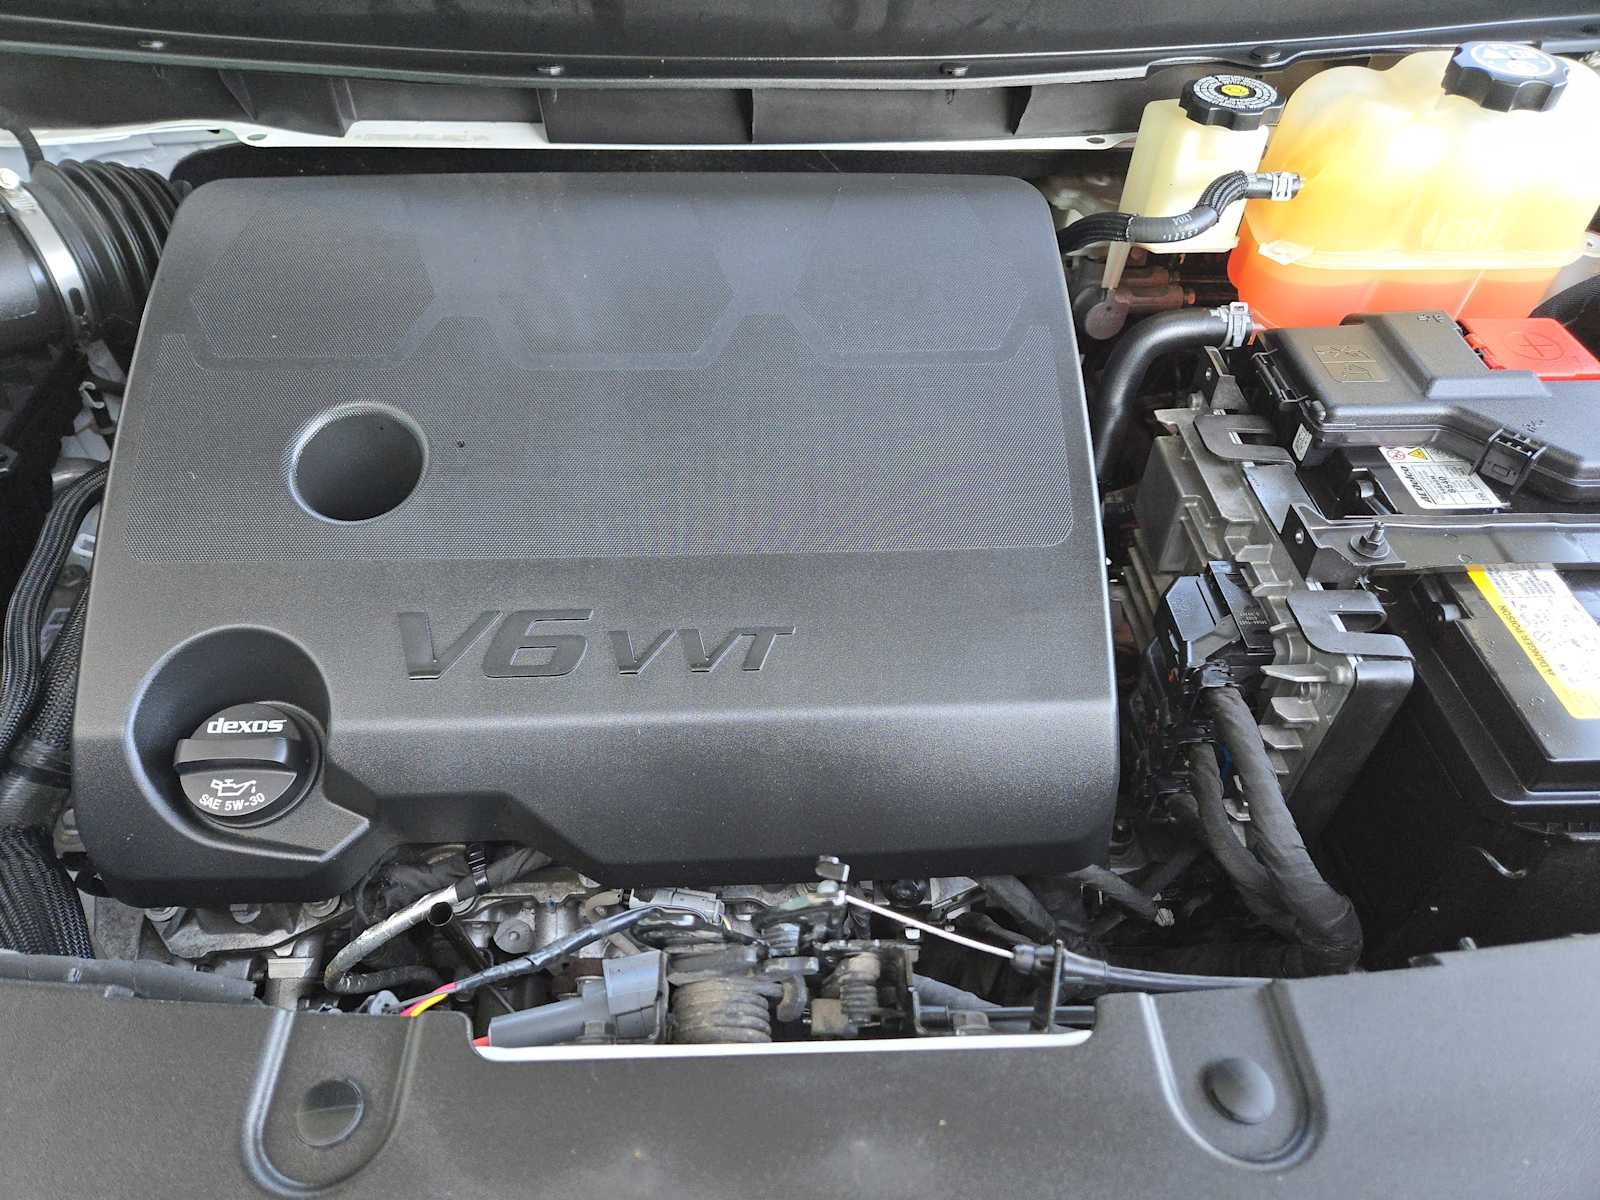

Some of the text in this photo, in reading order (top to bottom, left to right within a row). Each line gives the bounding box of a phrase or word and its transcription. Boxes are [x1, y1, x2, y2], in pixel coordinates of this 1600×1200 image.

[398, 608, 796, 680] V6 VVT
[206, 717, 287, 734] dexos
[199, 792, 266, 811] SAE 5W-30
